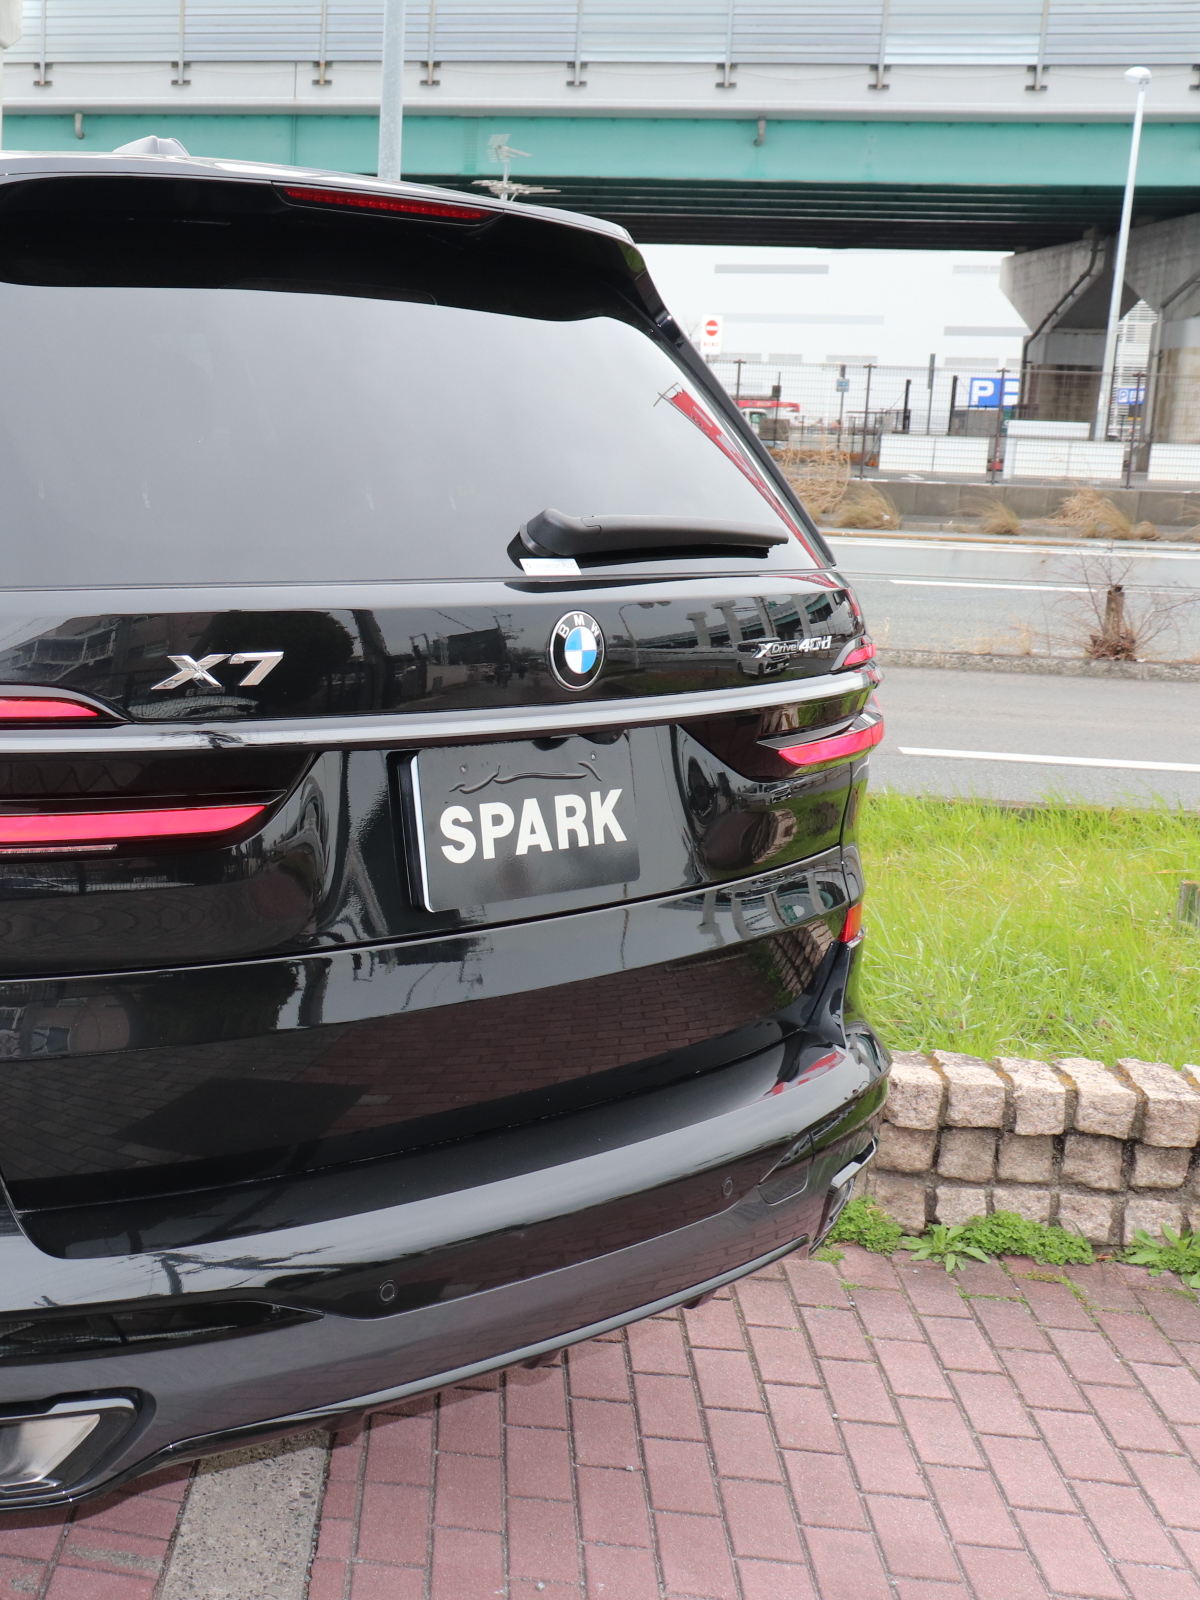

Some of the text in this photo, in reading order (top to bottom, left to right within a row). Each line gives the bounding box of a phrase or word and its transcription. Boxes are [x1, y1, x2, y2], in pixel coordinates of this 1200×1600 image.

[971, 380, 994, 406] P
[558, 614, 601, 639] BMW
[151, 651, 284, 690] X7
[440, 789, 627, 864] SPARK
